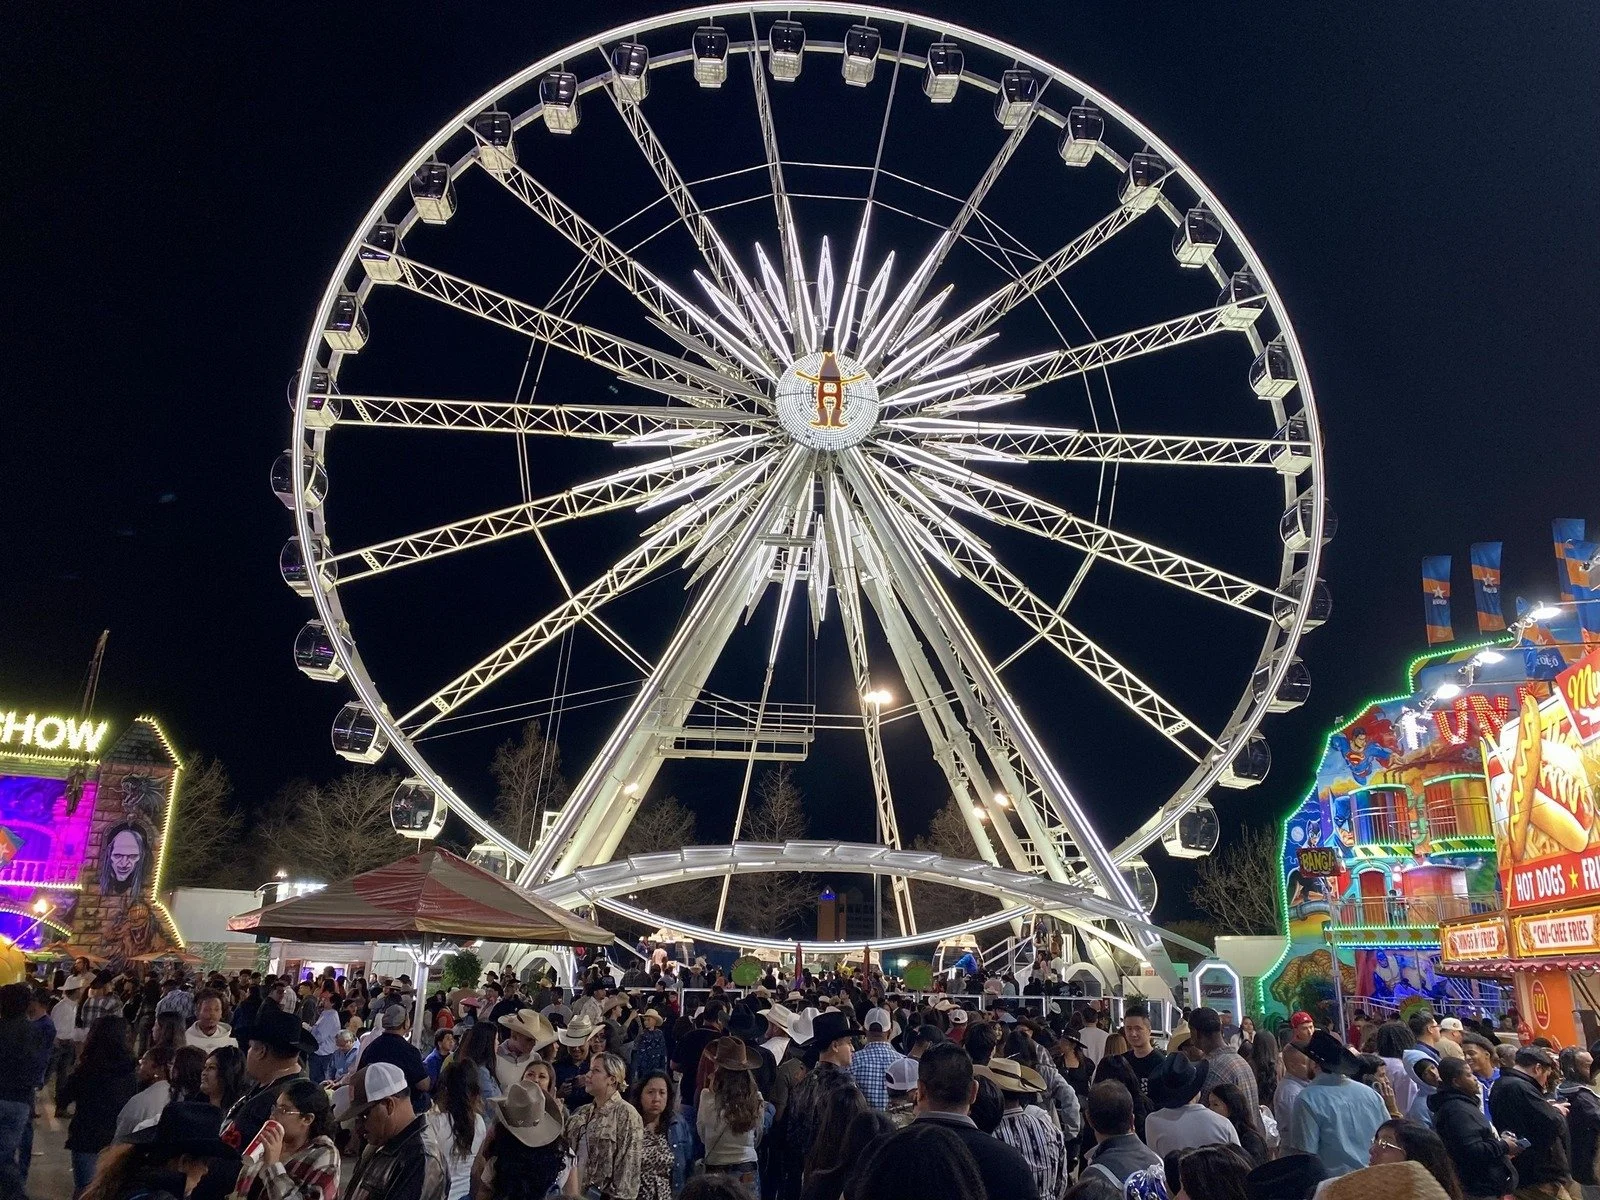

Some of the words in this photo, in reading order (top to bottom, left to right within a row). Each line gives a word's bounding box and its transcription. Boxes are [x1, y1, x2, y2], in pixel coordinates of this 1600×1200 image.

[1401, 695, 1509, 750] FUN
[1301, 851, 1334, 873] BANG!
[1514, 871, 1536, 902] HOT
[1535, 863, 1566, 898] DOGS
[1580, 855, 1600, 891] FRI
[1480, 930, 1496, 949] FRIES
[1567, 919, 1590, 942] FRIES
